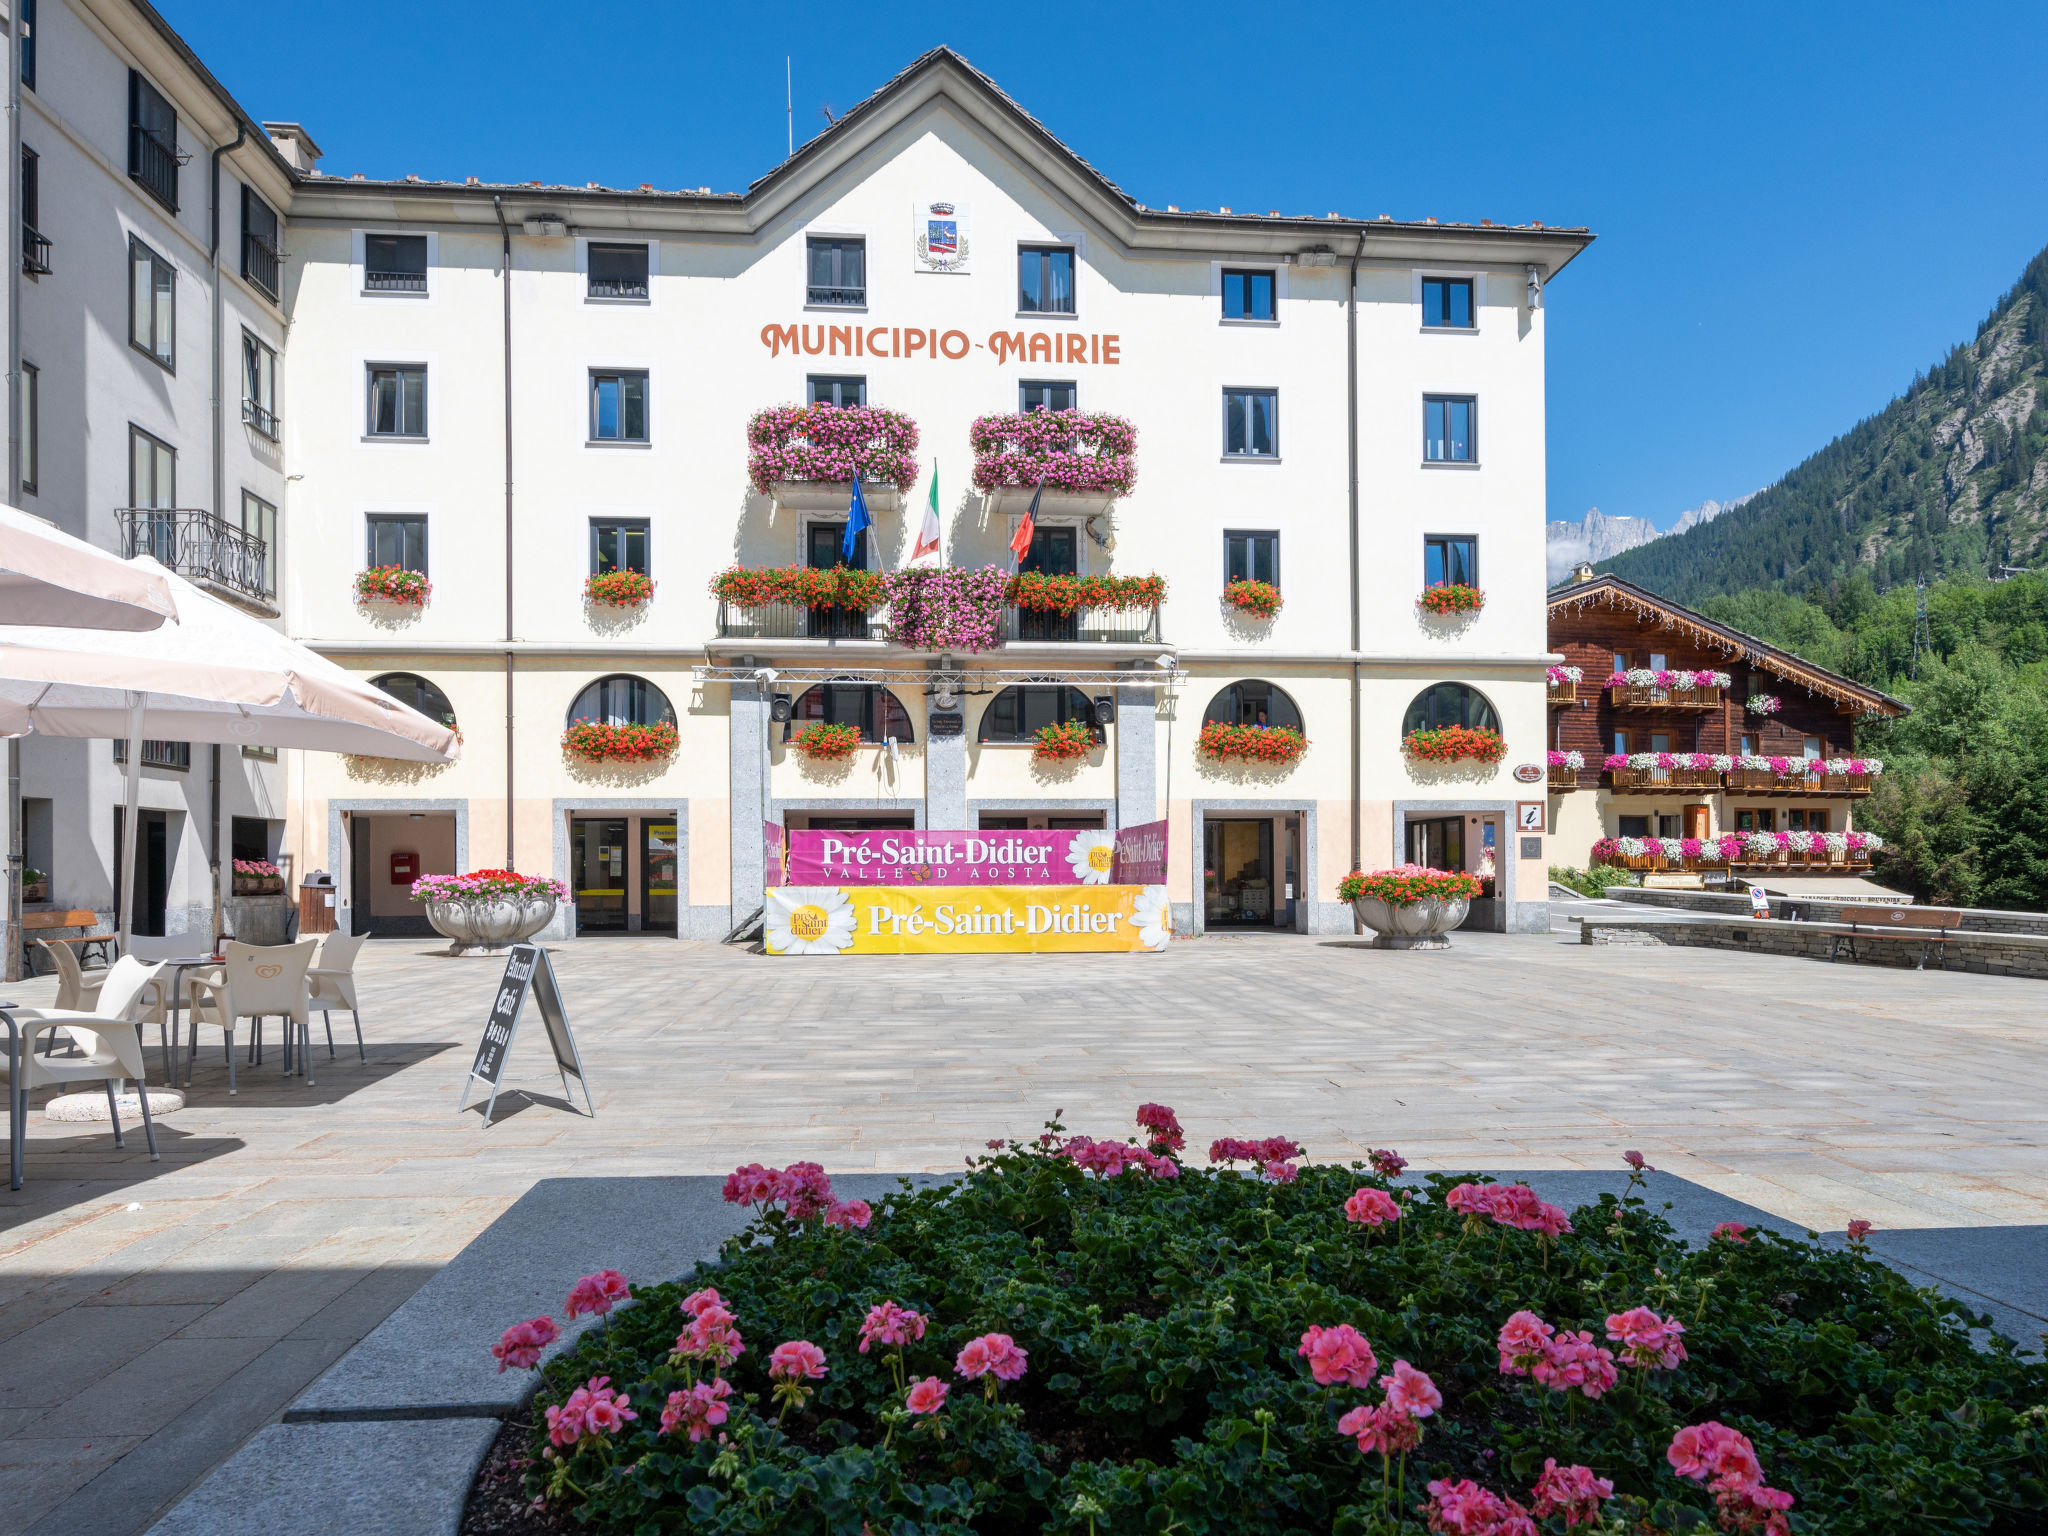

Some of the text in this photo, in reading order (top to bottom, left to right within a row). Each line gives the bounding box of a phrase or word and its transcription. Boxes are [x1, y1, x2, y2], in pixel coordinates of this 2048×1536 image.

[761, 323, 970, 360] MUNICIPIO
[988, 330, 1121, 366] MAIRIE
[821, 838, 1052, 865] Pré-Saint-Didier
[823, 868, 1051, 879] VALLE D'AOSTA
[790, 924, 823, 935] didier
[868, 904, 1123, 935] Pré-Saint-Didier
